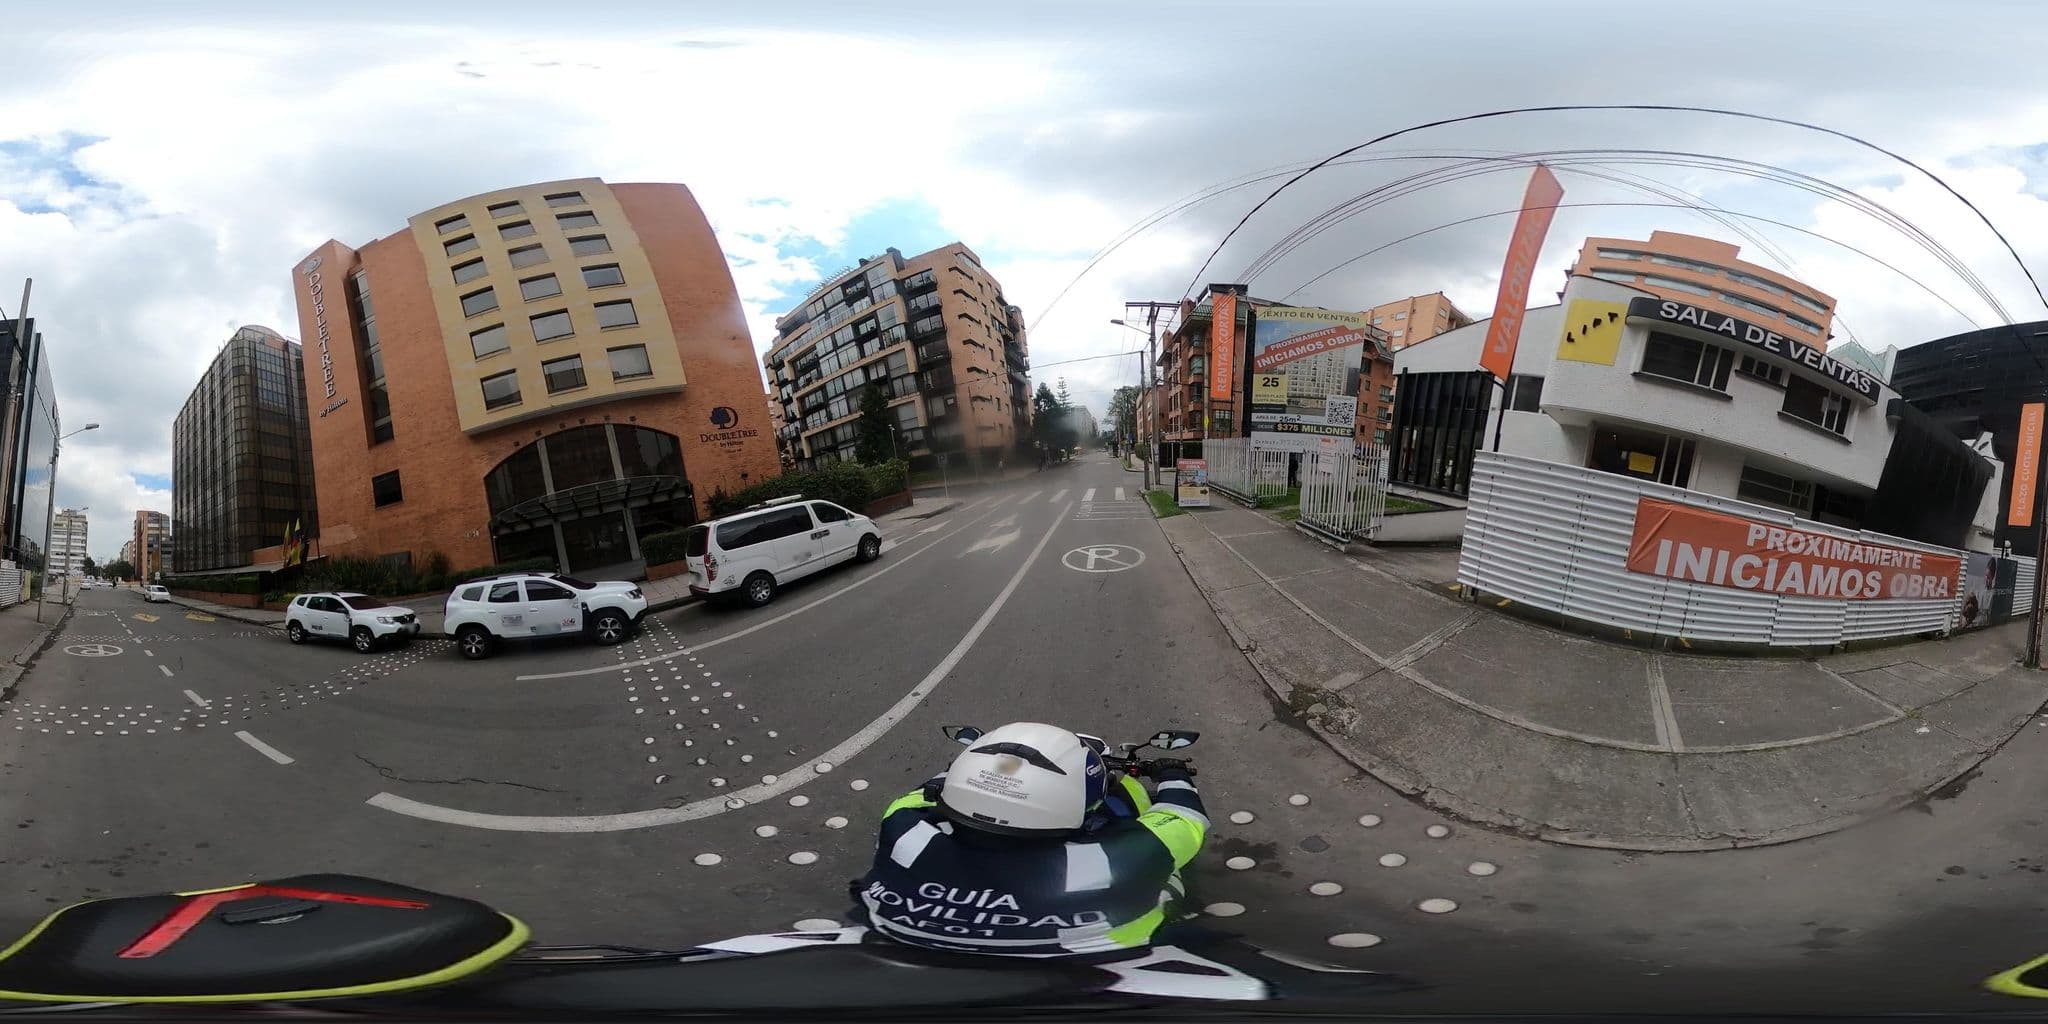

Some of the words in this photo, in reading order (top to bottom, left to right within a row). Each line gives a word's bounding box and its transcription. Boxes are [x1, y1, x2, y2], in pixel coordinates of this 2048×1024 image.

[309, 272, 337, 399] DOUBLETREE
[1300, 311, 1314, 319] EN
[1317, 313, 1360, 323] VENTAS!
[1217, 345, 1229, 392] RENTAS
[1257, 341, 1324, 368] INICIAMOS
[1327, 332, 1362, 346] OBRA
[1660, 301, 1736, 336] SALA
[1745, 322, 1785, 353] DE
[1788, 340, 1872, 394] VENTAS
[1262, 377, 1279, 387] 25
[1277, 423, 1299, 432] $375
[1301, 425, 1352, 436] MILLONES
[1655, 538, 1882, 597] INICIAMOS
[1890, 573, 1949, 599] OBRA
[1746, 523, 1922, 570] PROXIMAMENTE
[868, 881, 1108, 927] MOVILIDAD
[918, 882, 1020, 911] GUÍA
